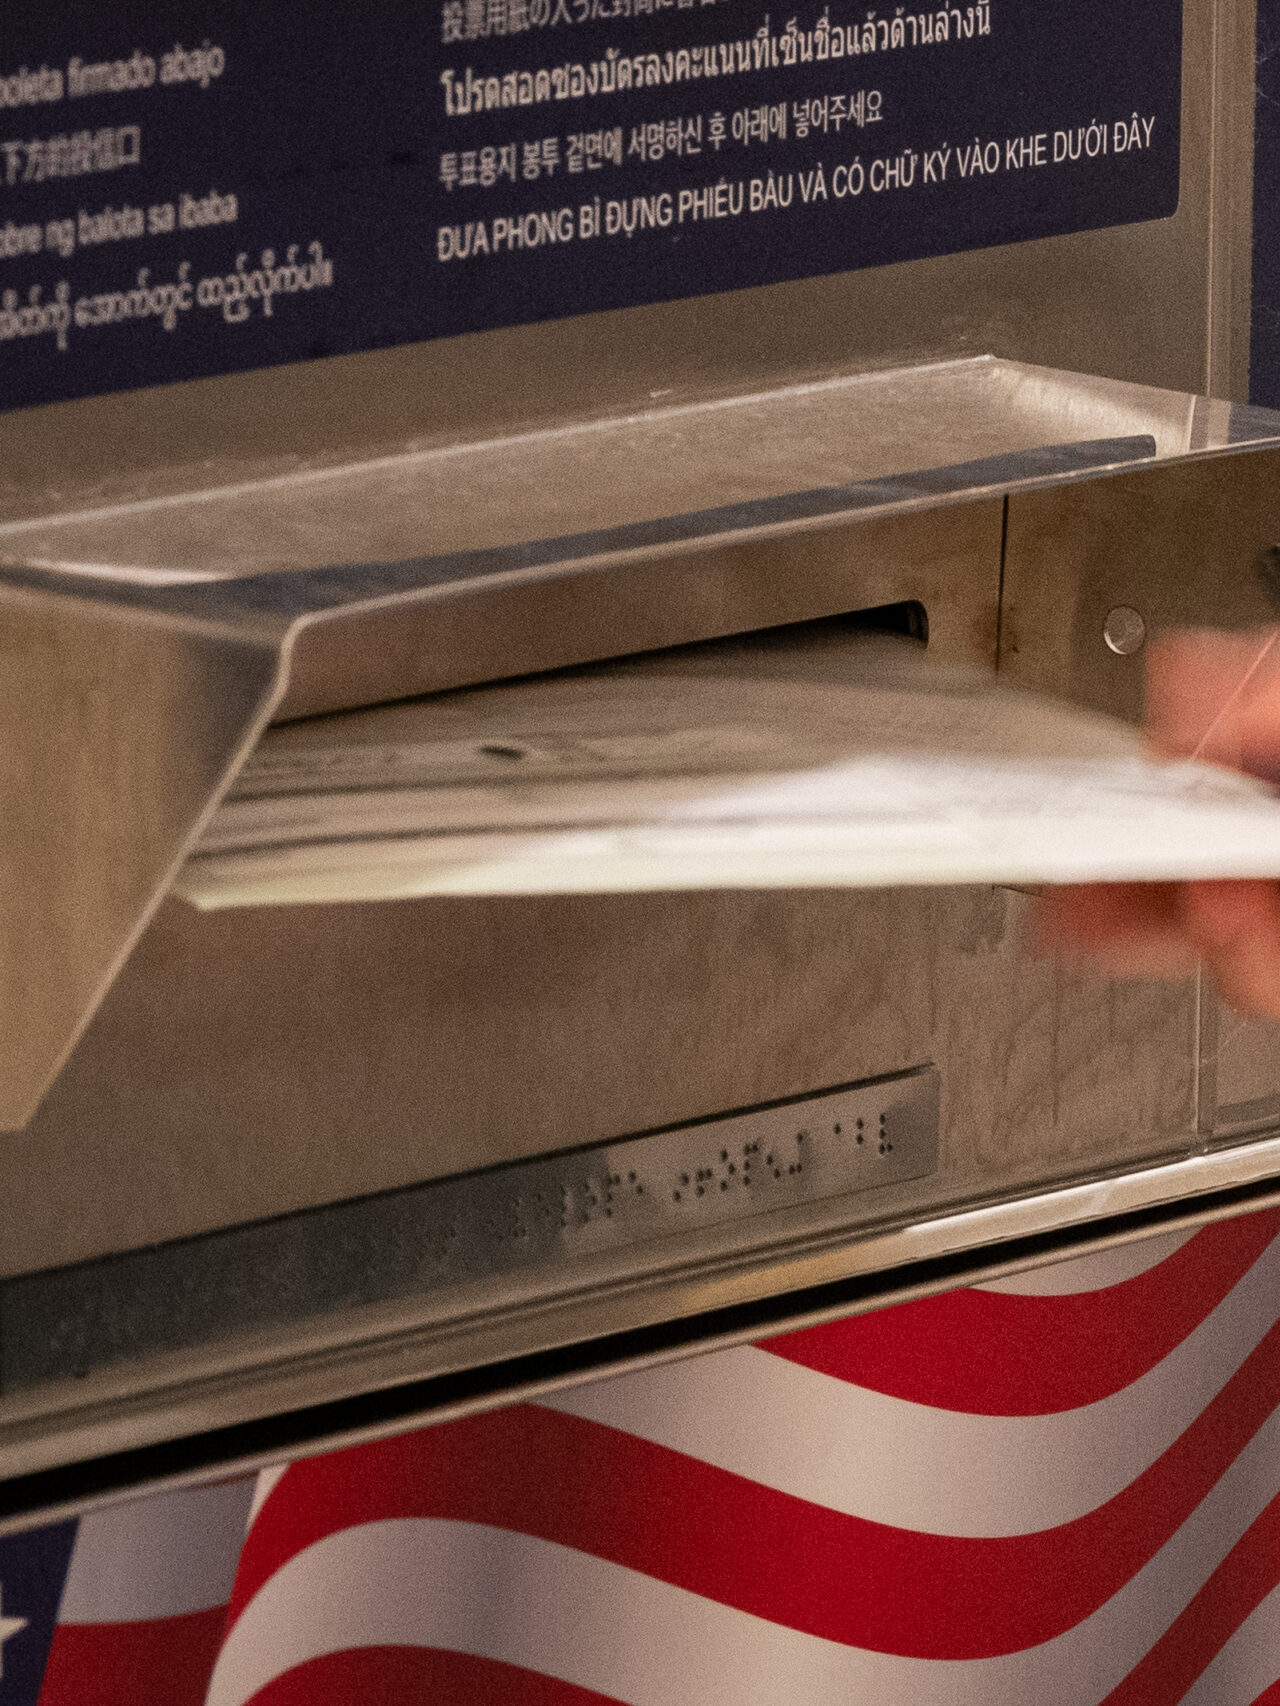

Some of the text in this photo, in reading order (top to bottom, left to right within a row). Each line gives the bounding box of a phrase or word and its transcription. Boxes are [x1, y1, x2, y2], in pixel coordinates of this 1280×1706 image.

[68, 50, 156, 97] firmado
[160, 39, 225, 88] abajo
[439, 90, 883, 191] 투표용지 봉투 겉면에 서명하신 후 아래에 넣어주세요
[492, 208, 574, 252] PHONG
[579, 196, 602, 240] BÌ
[606, 193, 673, 238] ĐỰNG
[678, 176, 744, 223] PHIẾU
[799, 162, 828, 203] VÀ
[832, 156, 865, 198] CÓ
[870, 149, 918, 193] CHỮ
[923, 142, 952, 184] KÝ
[956, 137, 1000, 178] VÀO
[1005, 133, 1048, 170] KHE
[1053, 118, 1108, 163] DƯỚI
[1112, 111, 1156, 153] ĐÂY
[45, 218, 76, 258] ng
[78, 204, 145, 246] balota
[147, 203, 176, 235] sa
